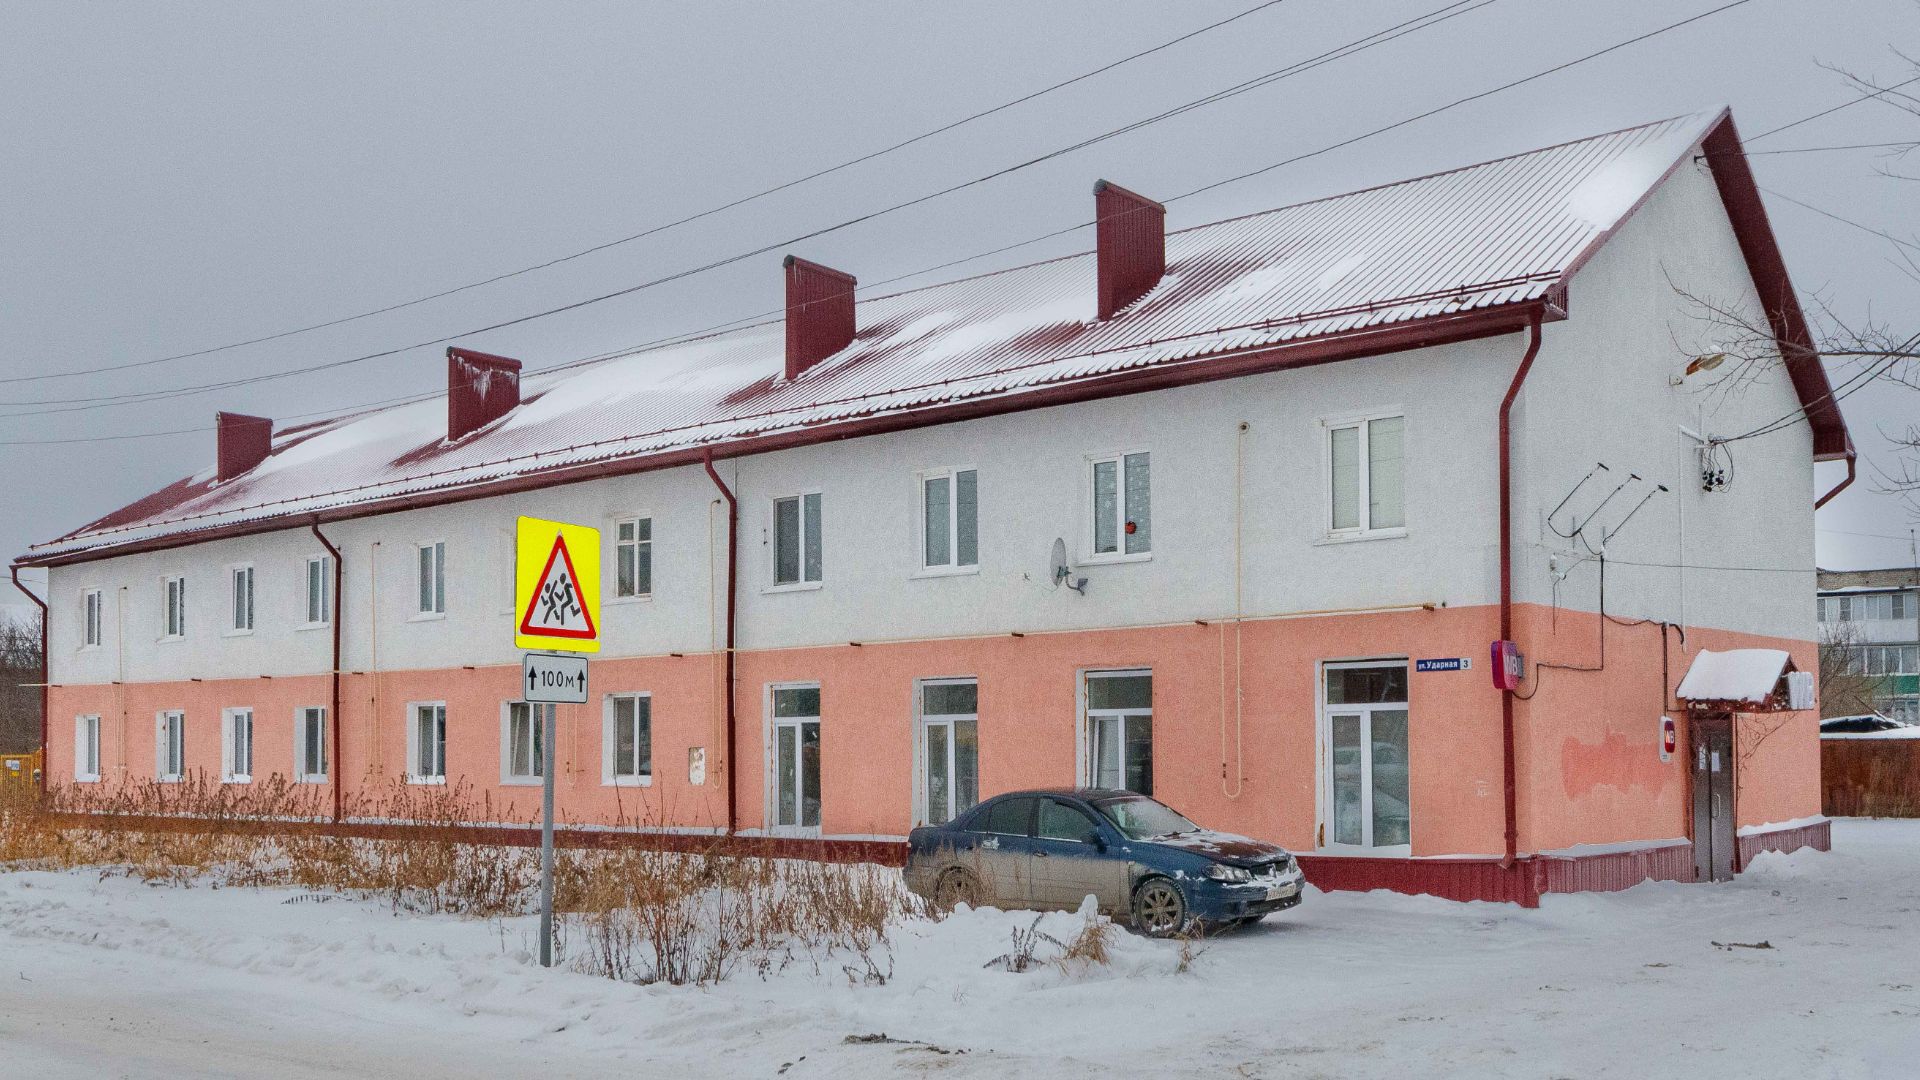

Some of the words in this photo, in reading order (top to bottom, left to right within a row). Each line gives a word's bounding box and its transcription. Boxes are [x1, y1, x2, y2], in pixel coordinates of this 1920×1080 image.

[1427, 661, 1458, 669] Ударная
[1463, 660, 1469, 668] 3
[1503, 655, 1518, 675] WB
